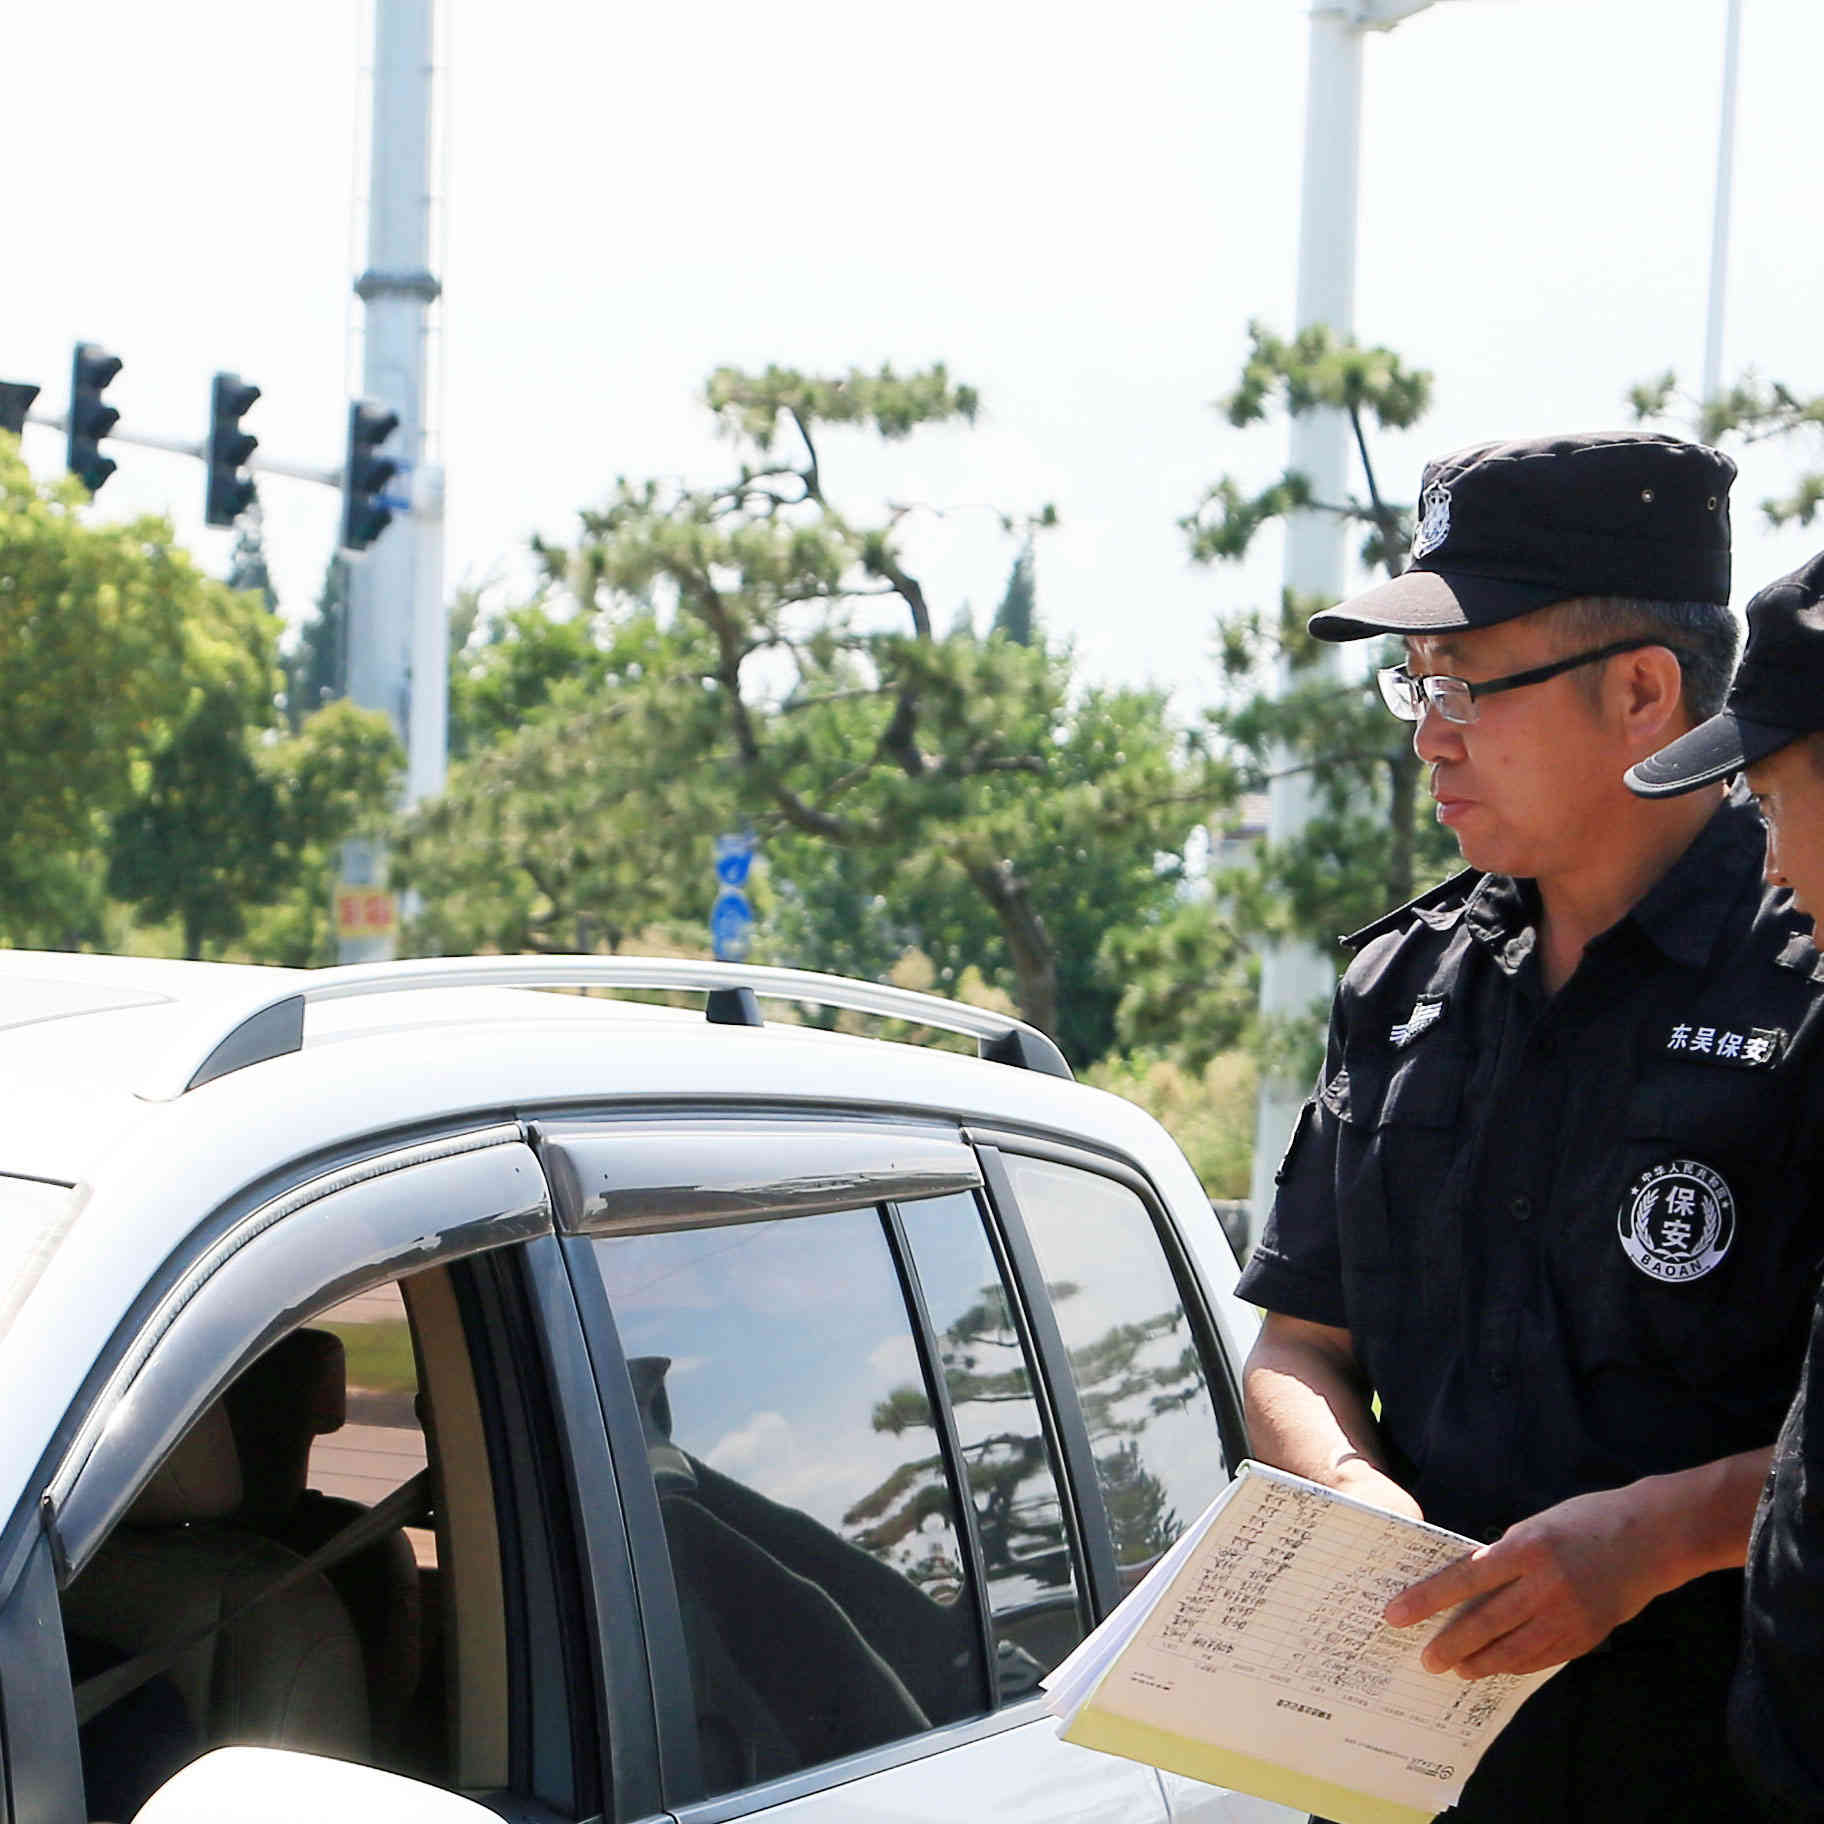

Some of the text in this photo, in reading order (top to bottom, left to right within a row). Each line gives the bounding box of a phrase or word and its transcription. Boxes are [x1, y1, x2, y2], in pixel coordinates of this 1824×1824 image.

[1667, 1023, 1769, 1062] 东吴保安
[1661, 1185, 1696, 1250] 保安
[1641, 1254, 1703, 1276] BAOAN
